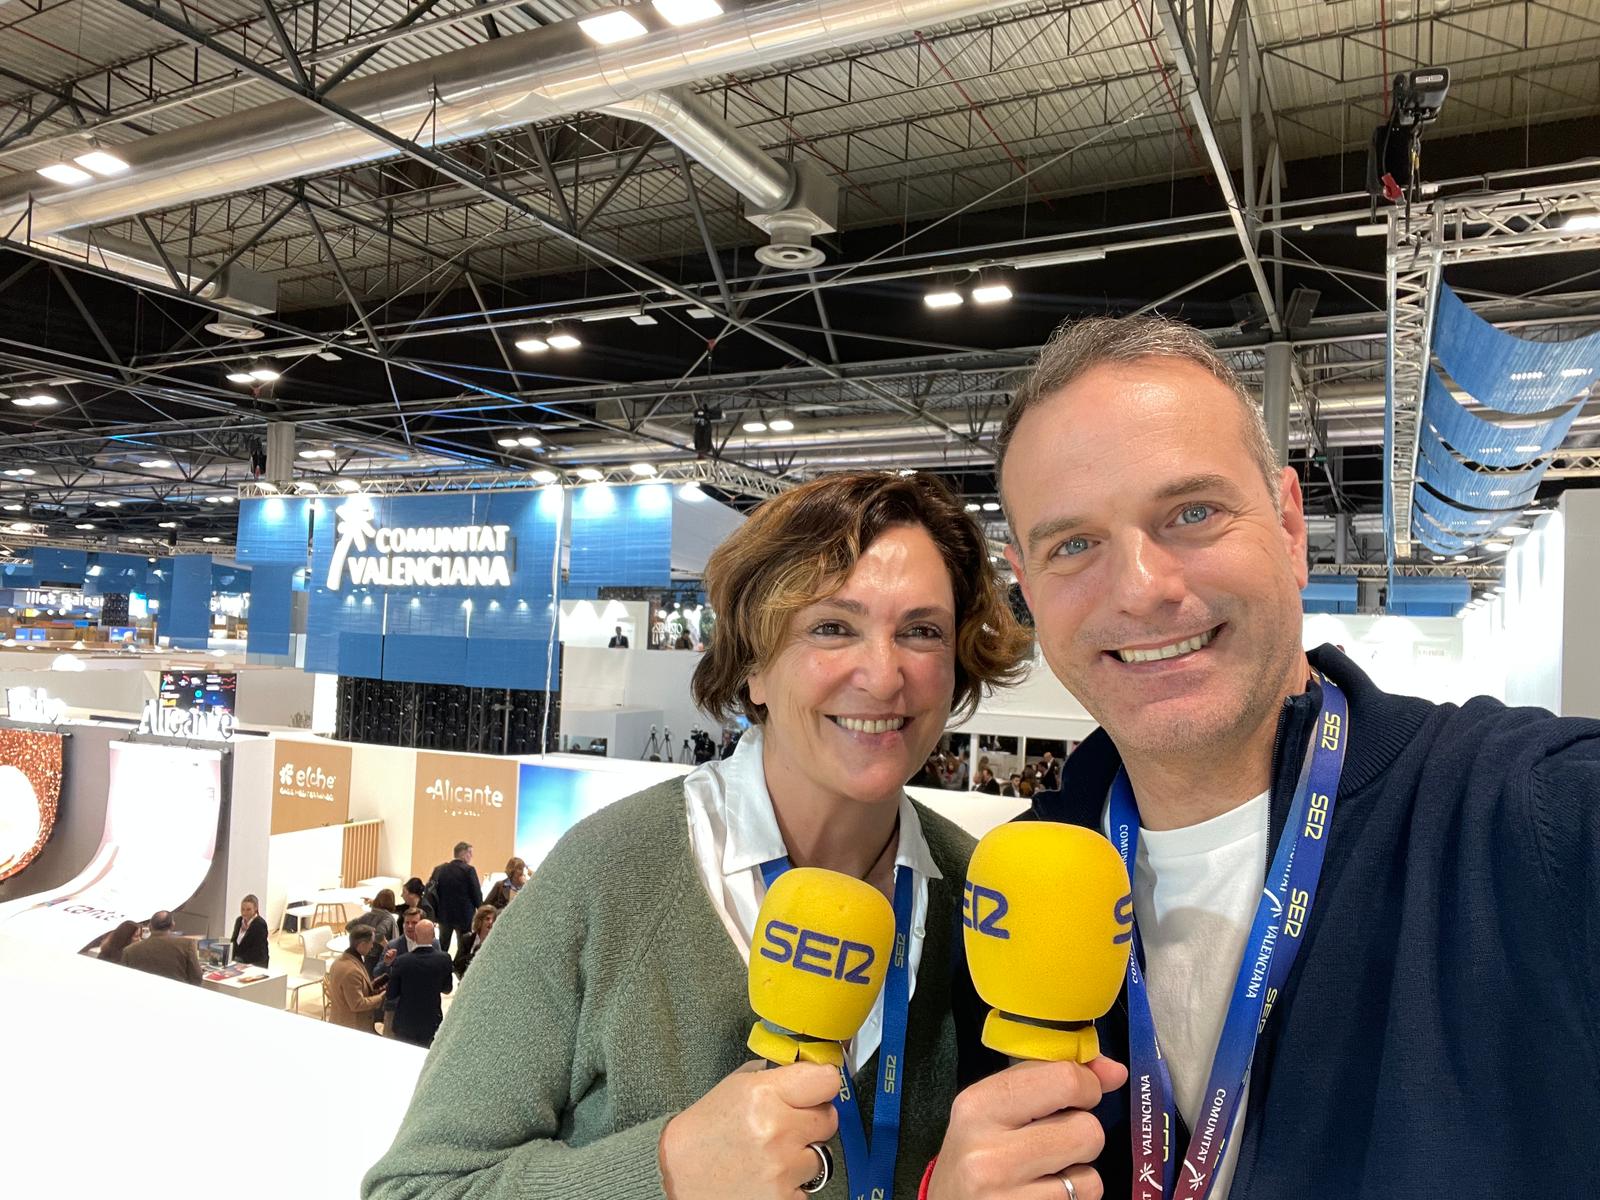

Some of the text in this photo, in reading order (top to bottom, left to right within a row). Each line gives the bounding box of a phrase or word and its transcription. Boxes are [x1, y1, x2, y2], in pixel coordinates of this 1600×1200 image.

[375, 525, 510, 553] COMUNITAT
[348, 556, 511, 585] VALENCIANA
[1321, 711, 1341, 751] SER
[296, 766, 335, 789] elche
[432, 778, 504, 807] Alicante
[1304, 792, 1329, 841] SER
[1284, 887, 1309, 938] SER
[760, 920, 875, 985] SER
[1246, 925, 1279, 999] VALENCIANA
[884, 1055, 897, 1094] SER
[1140, 1075, 1153, 1156] VALENCIANA
[1197, 1088, 1227, 1164] COMUNITAT
